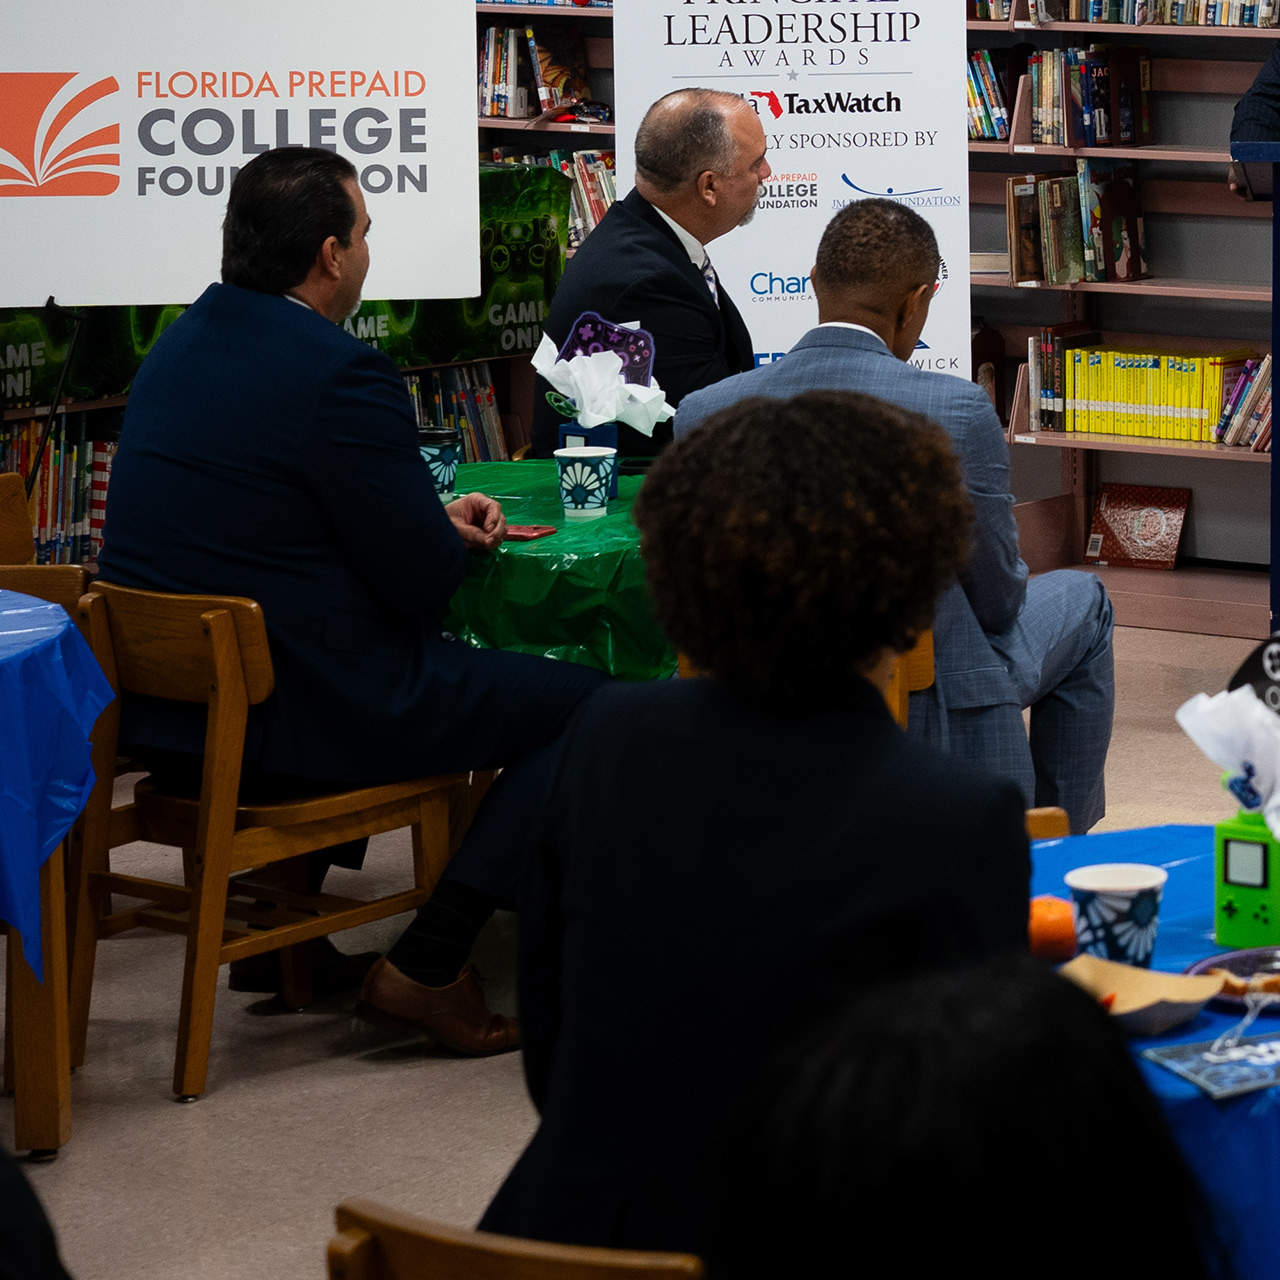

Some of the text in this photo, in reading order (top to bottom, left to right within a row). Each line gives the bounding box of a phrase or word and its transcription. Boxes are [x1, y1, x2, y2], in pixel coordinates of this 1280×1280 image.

[663, 12, 921, 46] LEADERSHIP
[718, 48, 869, 67] AWARDS
[137, 70, 426, 98] FLORIDA PREPAID
[783, 92, 901, 114] TaxWatch
[137, 107, 427, 156] COLLEGE
[789, 132, 908, 150] SPONSORED
[915, 131, 938, 146] BY
[137, 164, 427, 196] FOUON
[781, 173, 818, 182] PREPAID
[758, 183, 818, 198] OLLEGE
[893, 196, 961, 206] OUNDATION
[758, 199, 818, 210] UNDATION
[750, 272, 811, 295] Char
[752, 294, 817, 303] COMMUNICA
[488, 300, 544, 325] GAM
[501, 325, 539, 350] ON!
[0, 341, 46, 369] ME
[908, 357, 959, 370] WICK
